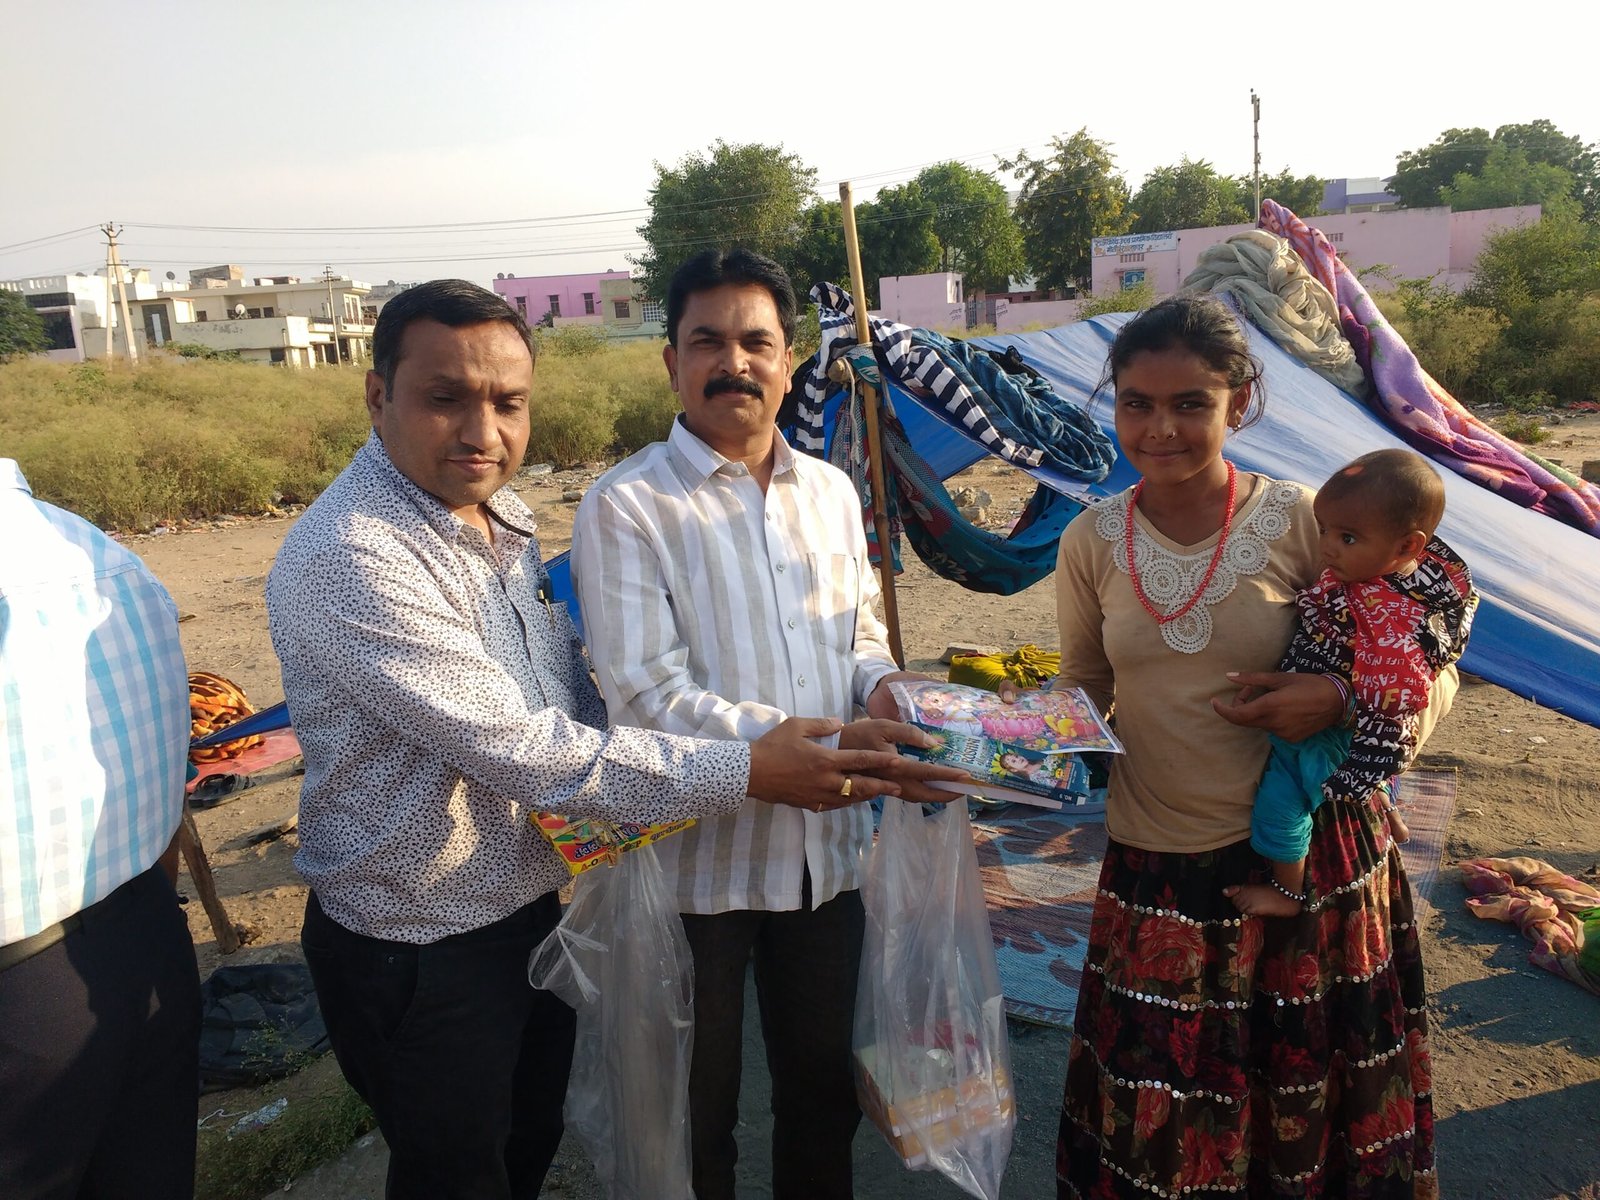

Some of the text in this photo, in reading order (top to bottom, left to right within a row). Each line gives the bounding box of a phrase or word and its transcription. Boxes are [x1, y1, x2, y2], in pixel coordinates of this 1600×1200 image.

[1427, 541, 1450, 559] REAL
[961, 737, 981, 765] ROSHNI
[1374, 756, 1394, 764] LIFE
